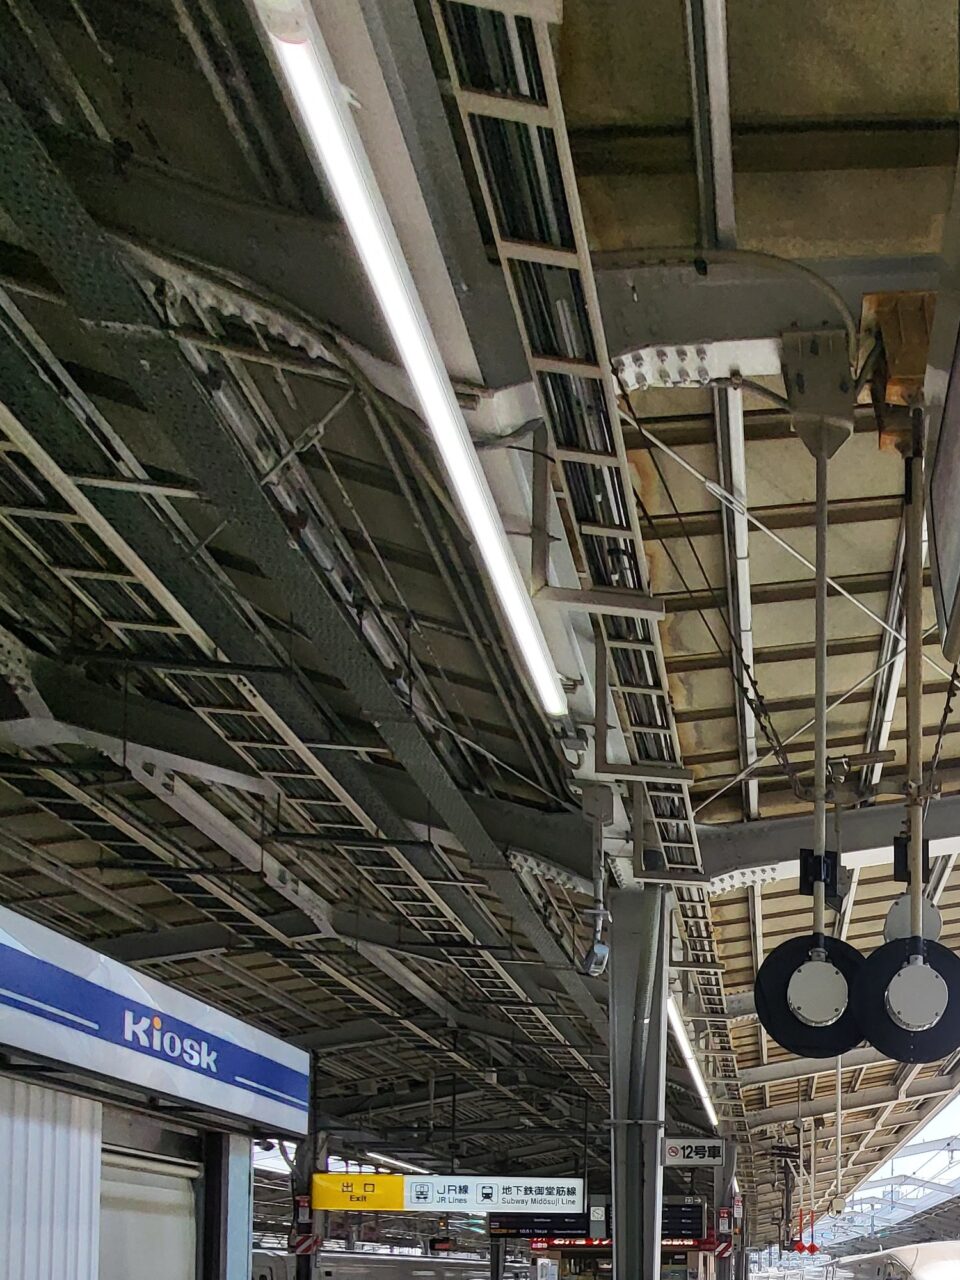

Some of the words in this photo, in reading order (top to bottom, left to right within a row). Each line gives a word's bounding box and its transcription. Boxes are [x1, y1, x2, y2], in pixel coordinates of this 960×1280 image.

[124, 1009, 218, 1073] Kiosk
[680, 1145, 722, 1160] 12号車
[342, 1182, 375, 1193] 出口
[437, 1185, 469, 1195] JR線
[501, 1185, 577, 1197] 地下鉄御堂筋線
[349, 1194, 367, 1202] Exit
[436, 1196, 446, 1204] JR
[448, 1196, 468, 1204] Lines
[501, 1197, 528, 1206] Subway
[561, 1198, 576, 1206] Line
